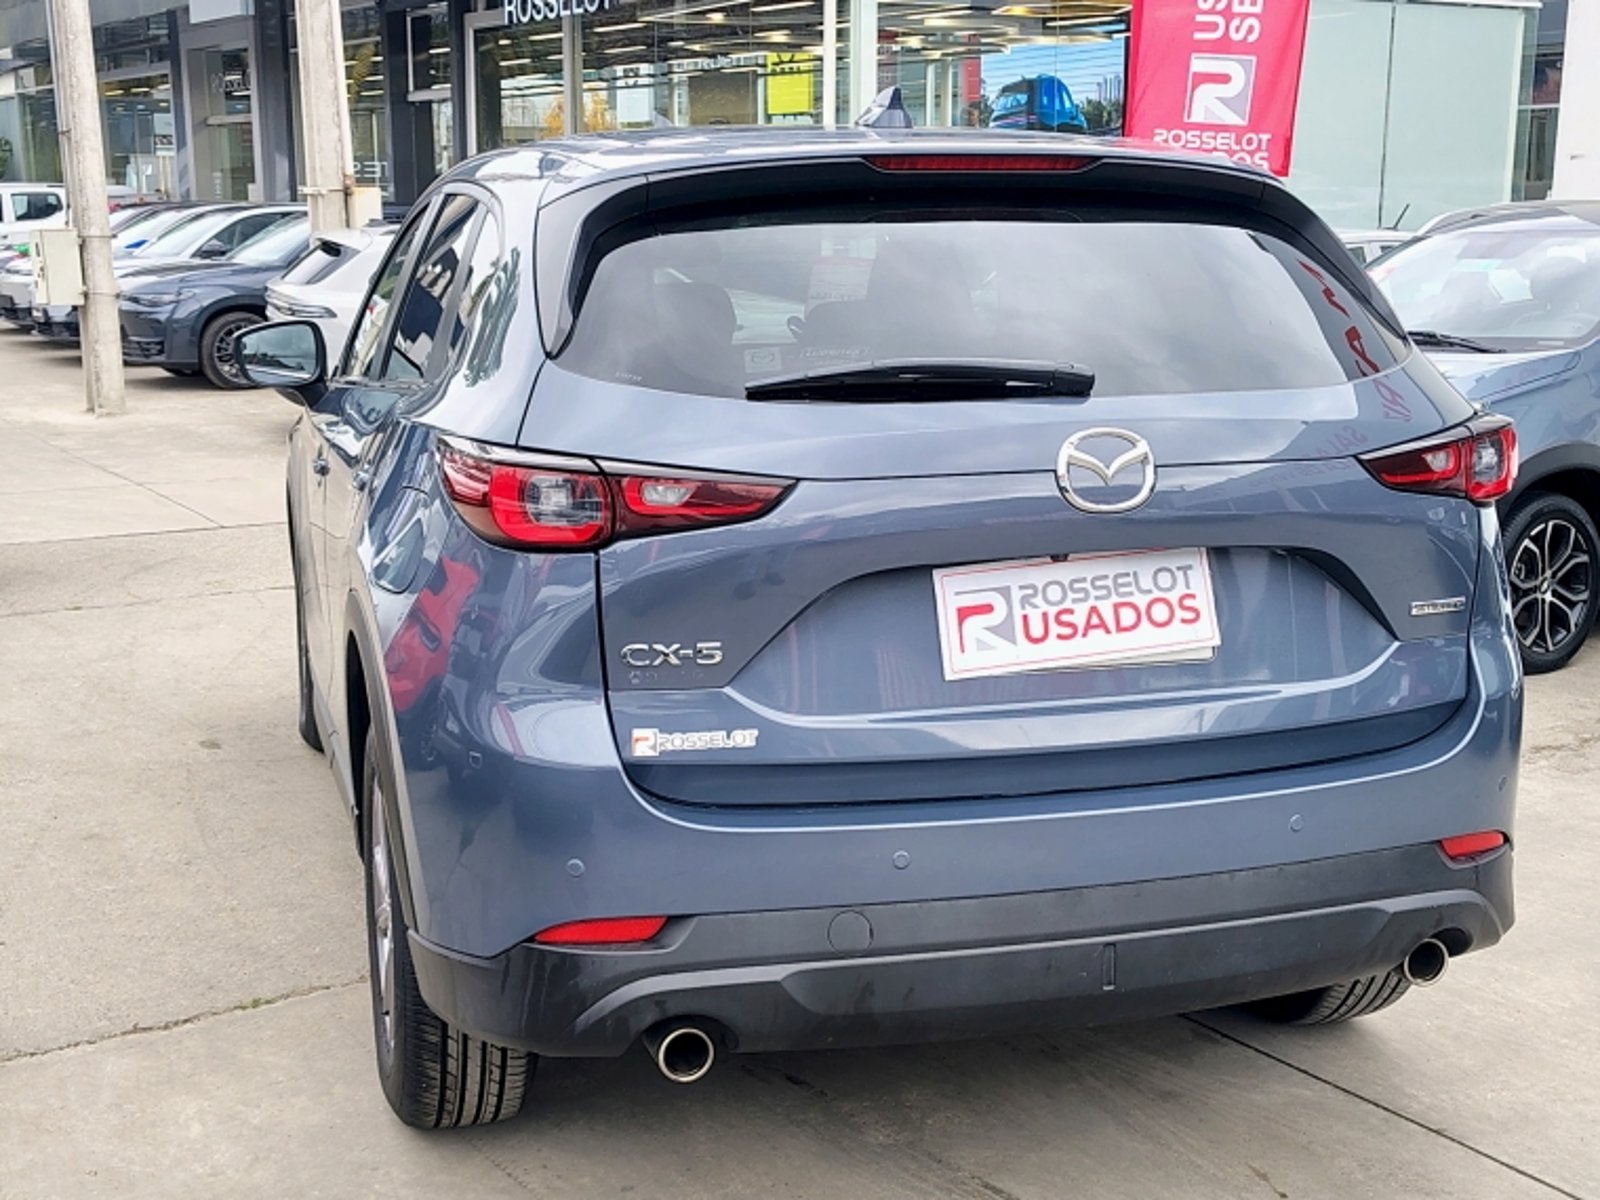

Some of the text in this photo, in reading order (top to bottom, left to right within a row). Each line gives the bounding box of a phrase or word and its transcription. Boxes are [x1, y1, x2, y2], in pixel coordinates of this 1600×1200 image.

[504, 0, 609, 25] ROSS
[1153, 129, 1272, 151] ROSSELOT
[1018, 564, 1194, 610] ROSSELOT
[1021, 593, 1201, 645] USADOS
[620, 642, 723, 667] CX-5
[659, 730, 758, 749] ROSSELOT
